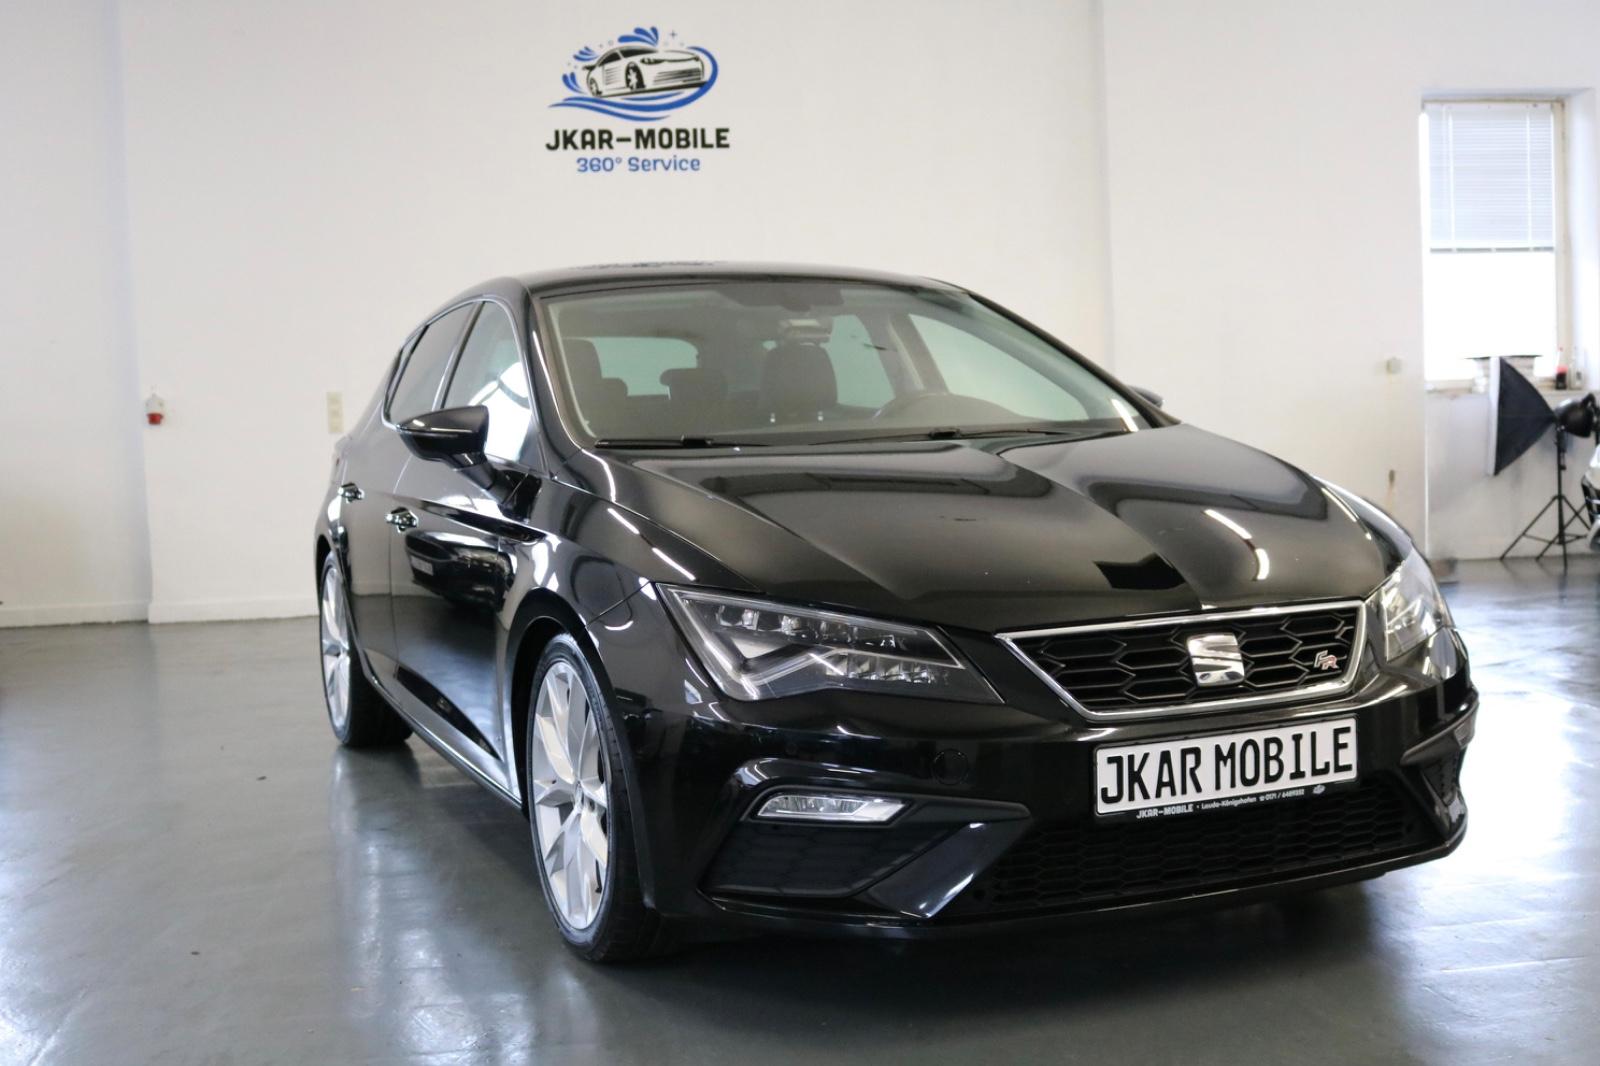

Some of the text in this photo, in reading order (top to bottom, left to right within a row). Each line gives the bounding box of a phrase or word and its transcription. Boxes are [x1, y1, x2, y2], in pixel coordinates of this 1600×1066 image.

[545, 127, 731, 151] JKAR-MOBILE
[576, 154, 701, 173] 360° Service
[1100, 726, 1353, 804] JKAR MOBILE
[1136, 803, 1194, 819] JKAR-MOBILE
